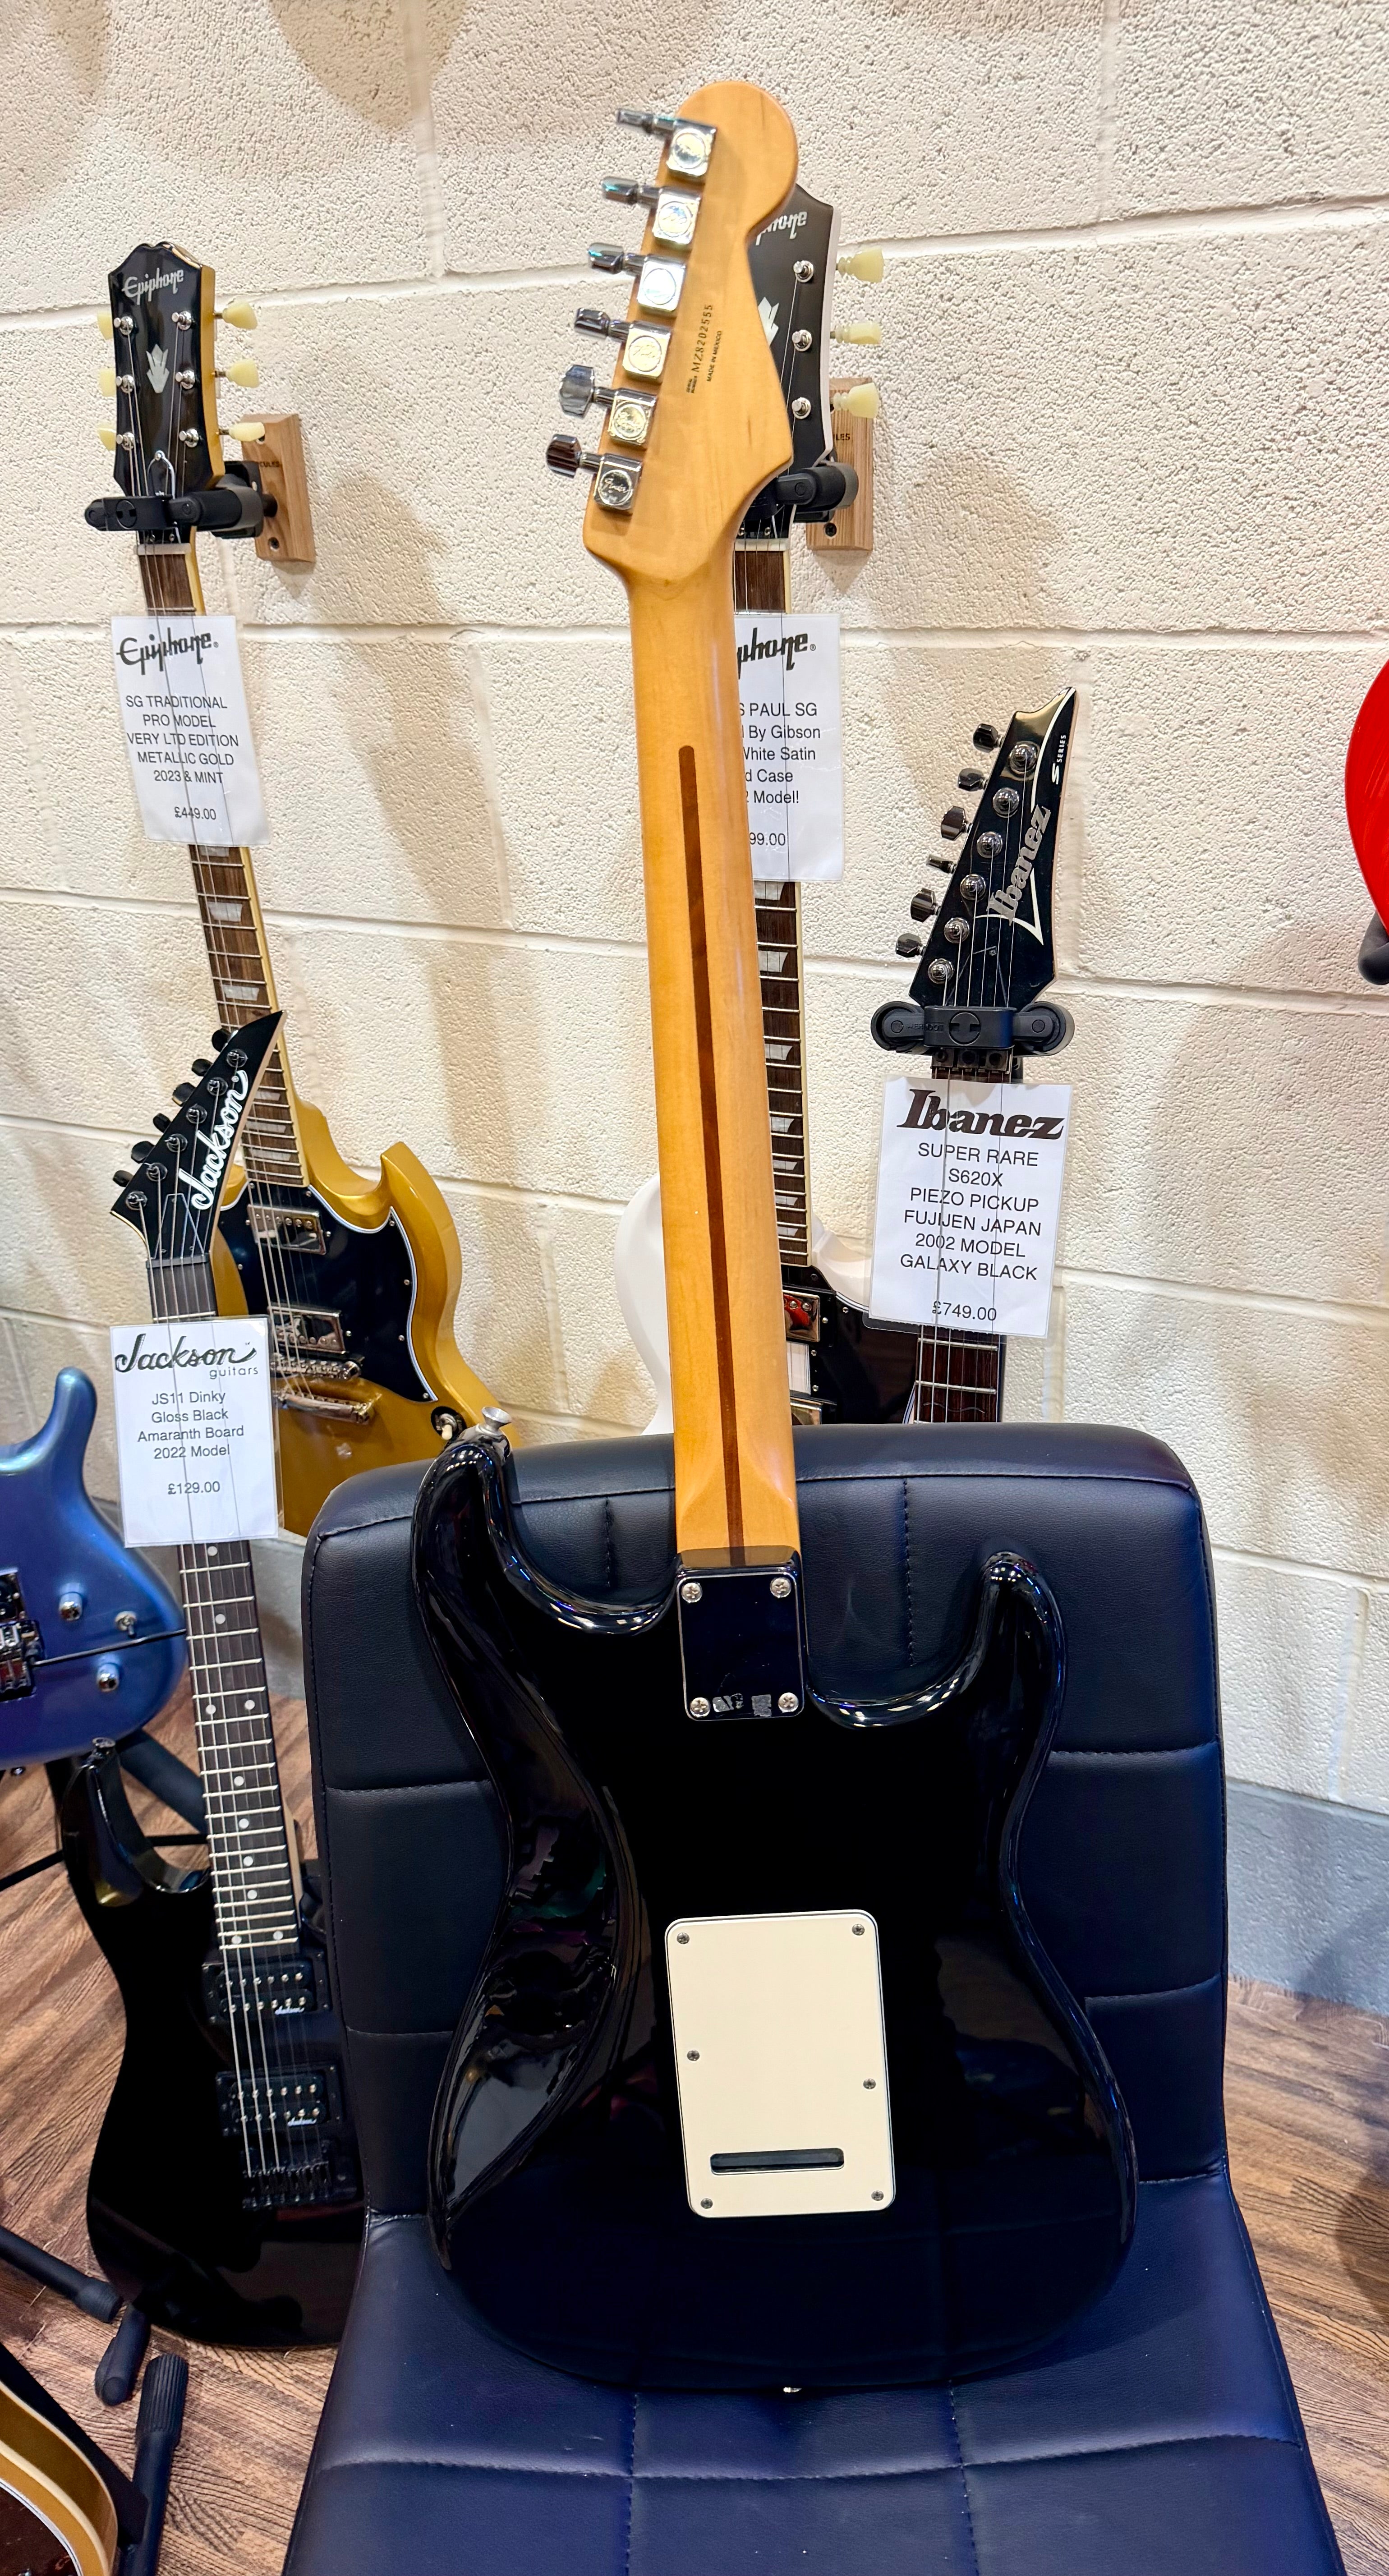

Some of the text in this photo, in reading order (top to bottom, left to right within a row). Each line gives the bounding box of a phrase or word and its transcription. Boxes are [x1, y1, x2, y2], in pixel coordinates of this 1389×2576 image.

[122, 267, 184, 305] Epiphone
[691, 304, 713, 373] MZ8202555
[707, 364, 715, 382] MADE
[713, 331, 722, 355] MEXICO
[126, 696, 227, 708] SG TRADITIONAL
[750, 703, 790, 716] PAUL
[795, 703, 818, 717] SG
[143, 715, 216, 727] PRO MODEL
[127, 733, 239, 746] VERY LTD EDITION
[749, 725, 766, 741] By
[771, 725, 821, 739] Gibson
[781, 747, 816, 761] Satin
[1056, 735, 1067, 763] SERIES
[138, 752, 234, 765] METALLIC GOLD
[154, 770, 224, 784] 2023 & MINT
[757, 768, 793, 782] Case
[754, 791, 799, 804] Model!
[175, 807, 216, 820] £449.00
[986, 805, 1051, 925] Ibanez
[897, 1088, 1066, 1140] Ibanez
[178, 1069, 248, 1210] Jackson
[918, 1142, 1039, 1167] SUPER RARE
[948, 1168, 1003, 1187] S620X
[911, 1187, 1039, 1213] PIEZO PICKUP
[904, 1210, 1041, 1236] FUJIJEN JAPAN
[915, 1233, 1026, 1257] 2002 MODEL
[900, 1254, 1038, 1280] GALAXY BLACK
[932, 1301, 997, 1321] £749.00
[115, 1333, 257, 1373] Jackson
[209, 1366, 259, 1380] guitars
[152, 1390, 226, 1405] JS11 Dinky
[151, 1408, 229, 1423] Gloss Black
[138, 1425, 244, 1442] Amaranth Board
[154, 1444, 230, 1460] 2022 Model
[167, 1481, 221, 1495] £129.00
